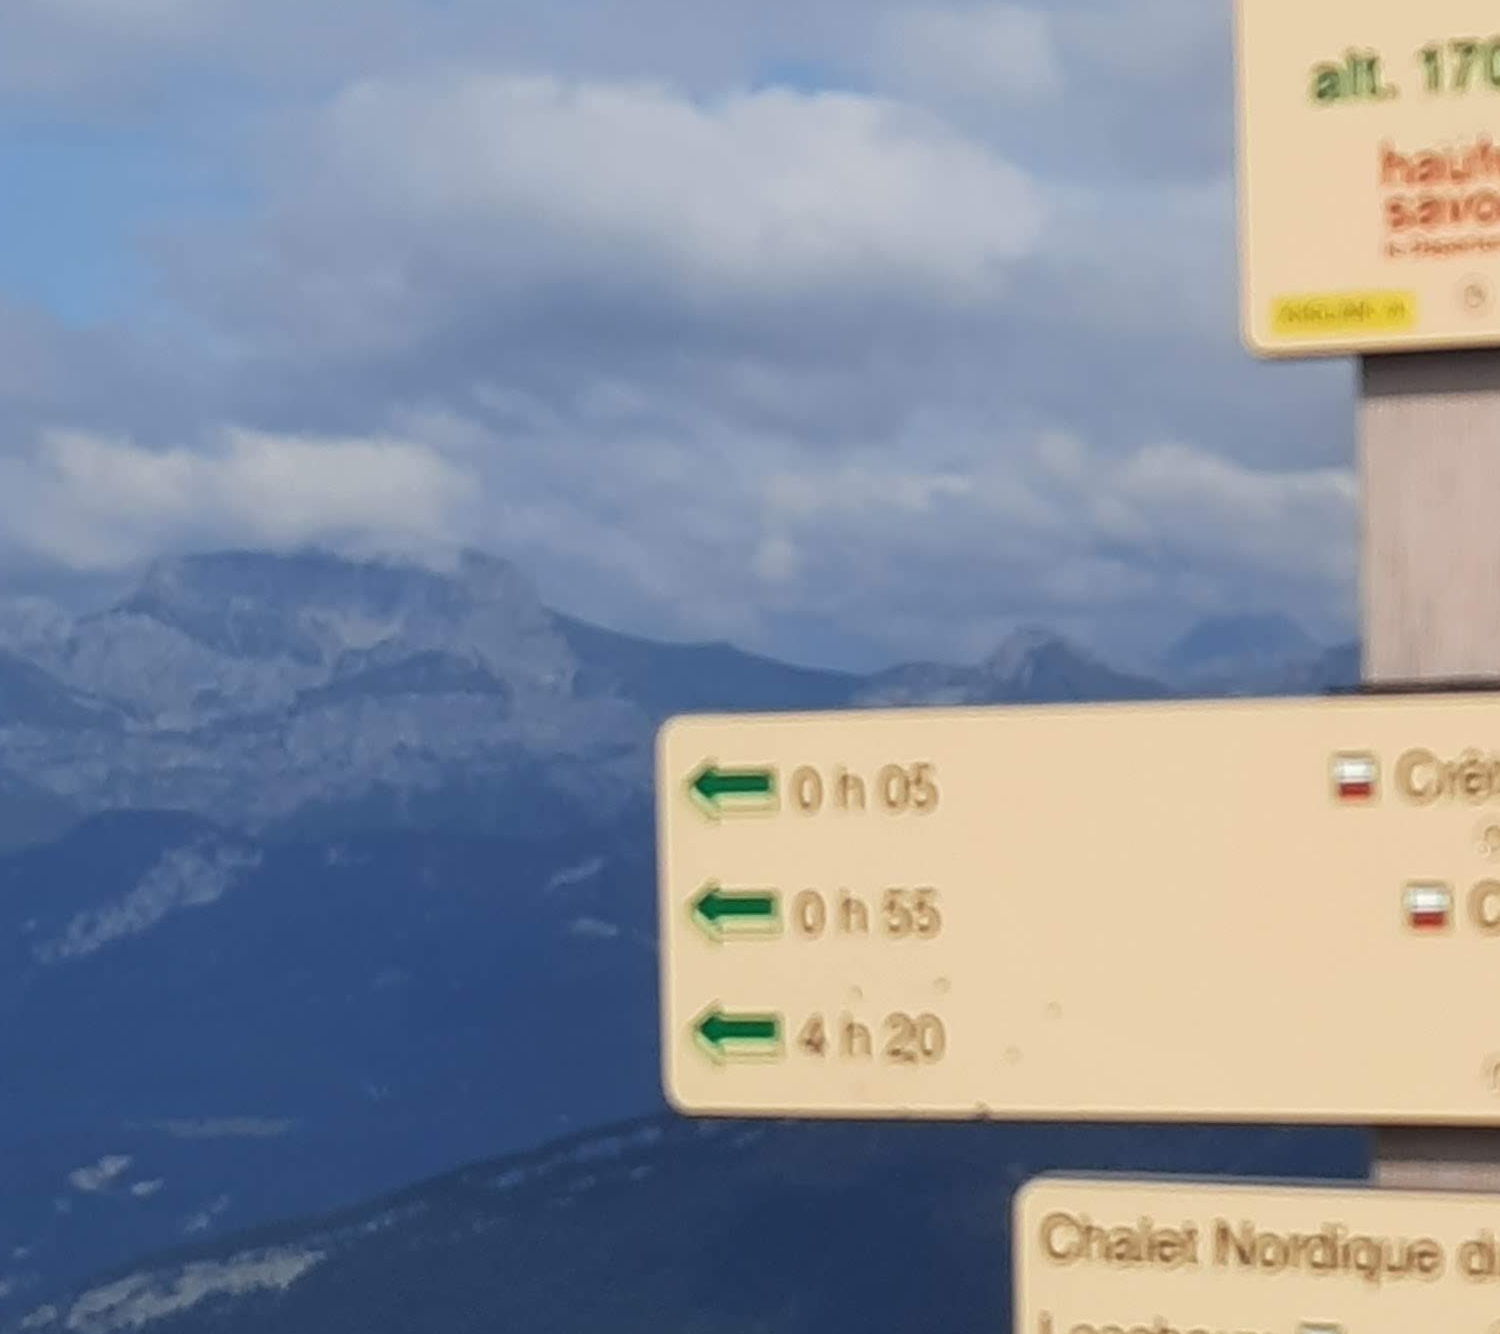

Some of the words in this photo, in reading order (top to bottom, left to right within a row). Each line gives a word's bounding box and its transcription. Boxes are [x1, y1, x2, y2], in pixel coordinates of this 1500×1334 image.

[1309, 47, 1398, 103] alt.
[790, 765, 824, 814] 0
[834, 763, 867, 811] h
[877, 762, 939, 813] 05
[793, 889, 828, 940] 0
[837, 888, 869, 935] h
[883, 888, 942, 938] 55
[797, 1012, 828, 1059] 4
[840, 1010, 872, 1060] h
[886, 1012, 948, 1064] 20
[1040, 1213, 1198, 1268] Chalet
[1213, 1219, 1444, 1289] Nordique
